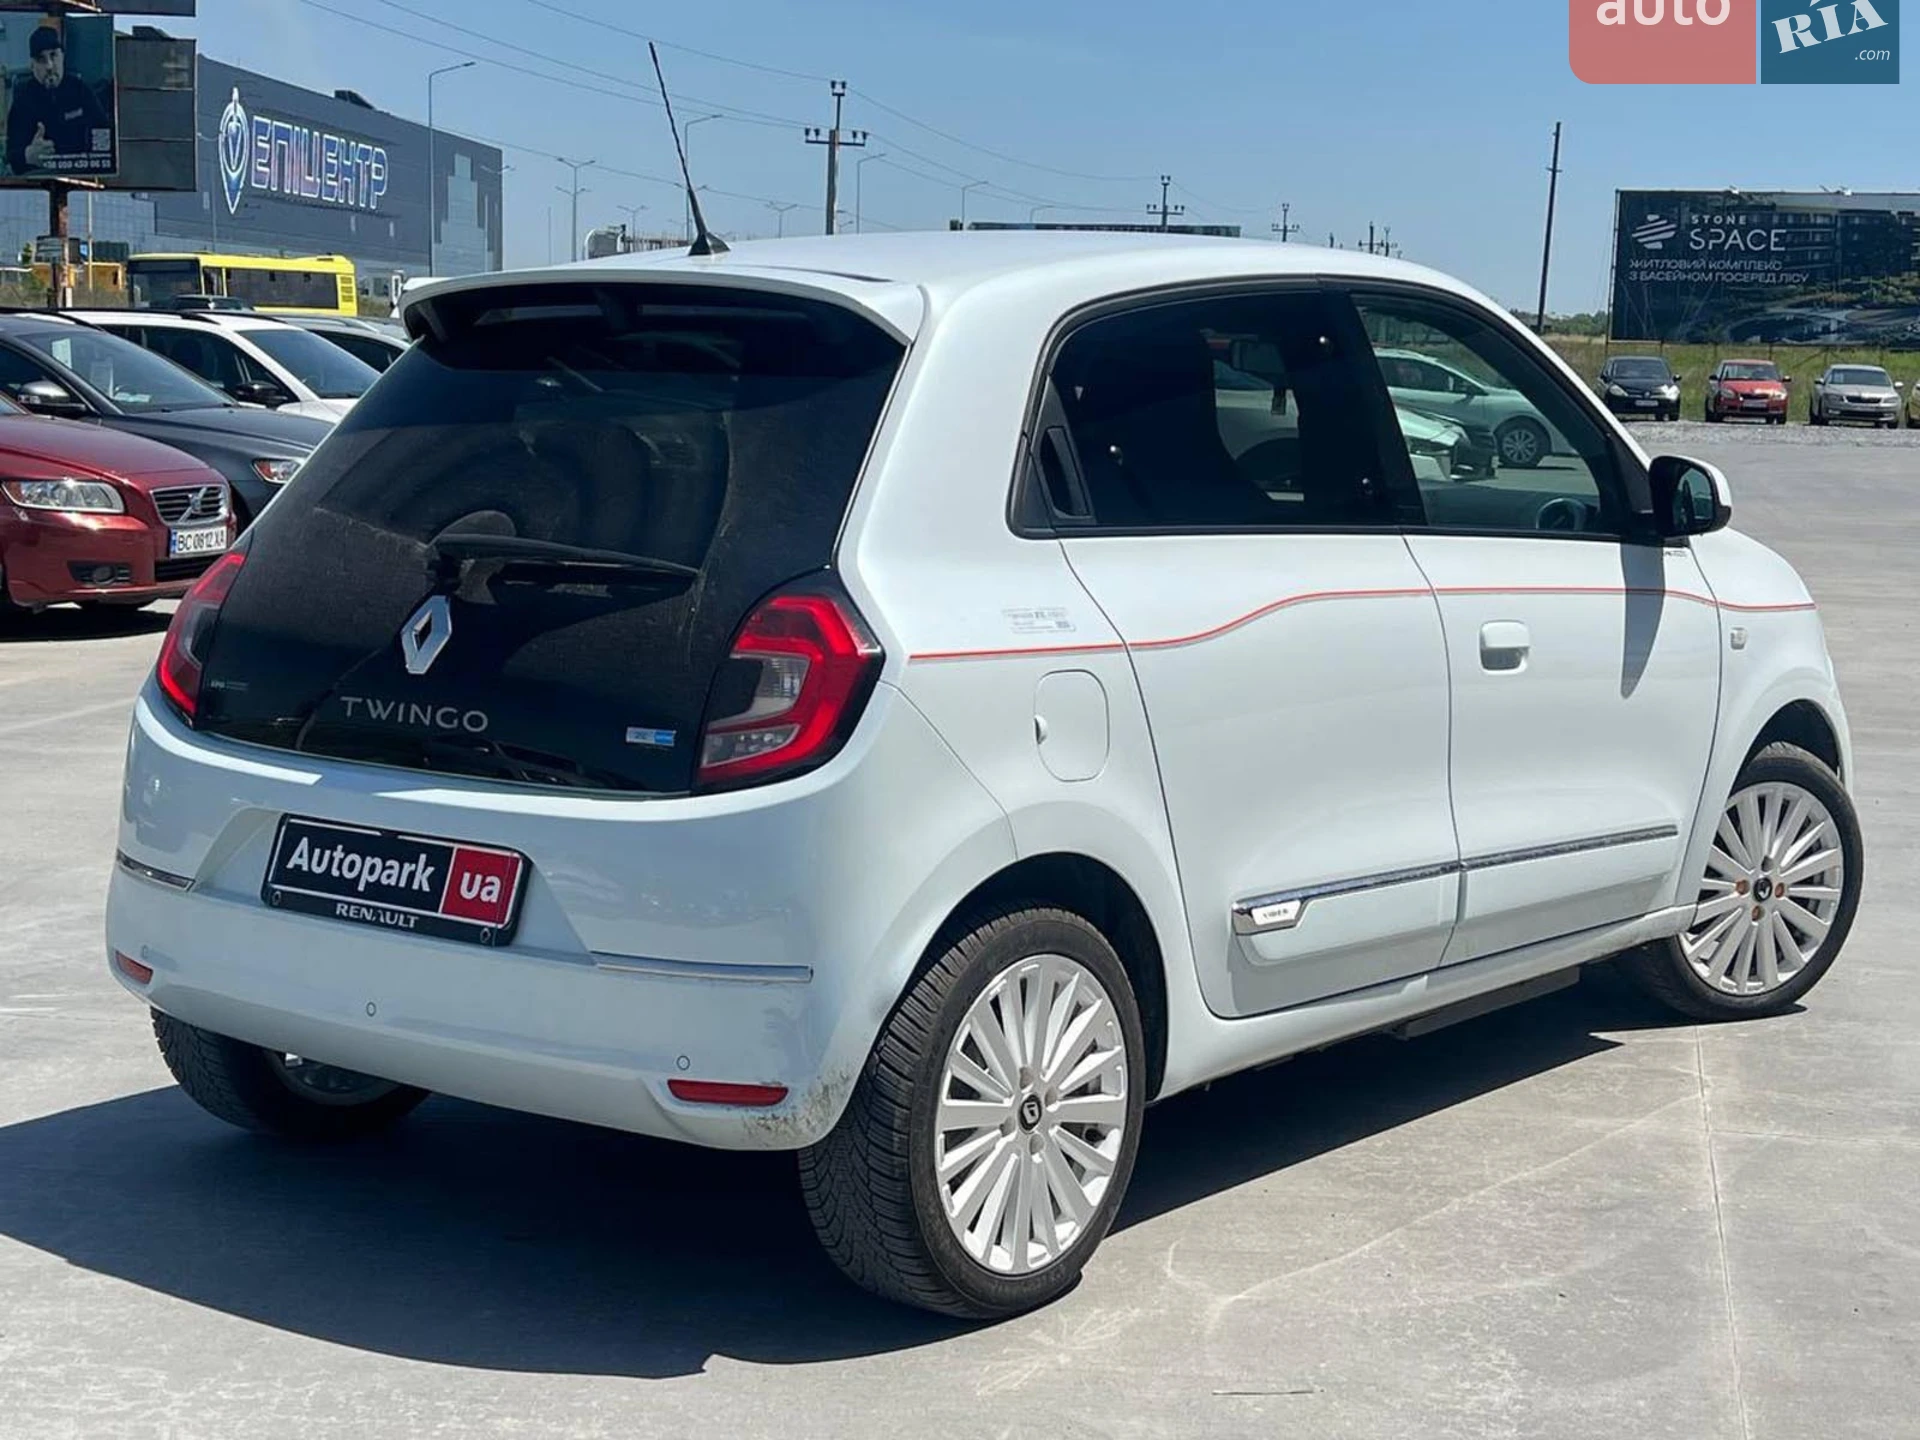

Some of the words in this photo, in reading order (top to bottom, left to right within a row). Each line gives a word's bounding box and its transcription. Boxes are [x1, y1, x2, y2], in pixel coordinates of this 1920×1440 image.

[251, 115, 389, 210] ЕПІЦЕНТР
[1691, 214, 1747, 225] STONE
[1689, 228, 1787, 251] SPACE
[1629, 258, 1706, 270] ЖИТЛОВИЙ
[1708, 259, 1782, 271] КОМПЛЕКС
[1640, 269, 1713, 282] БАСЕЙНОМ
[1715, 271, 1777, 284] ПОСЕРЕД
[1778, 272, 1810, 284] ЛІСУ
[340, 696, 489, 733] TWINGO
[286, 836, 435, 892] Autopark
[459, 870, 501, 903] ua
[335, 902, 420, 929] RENAULT
